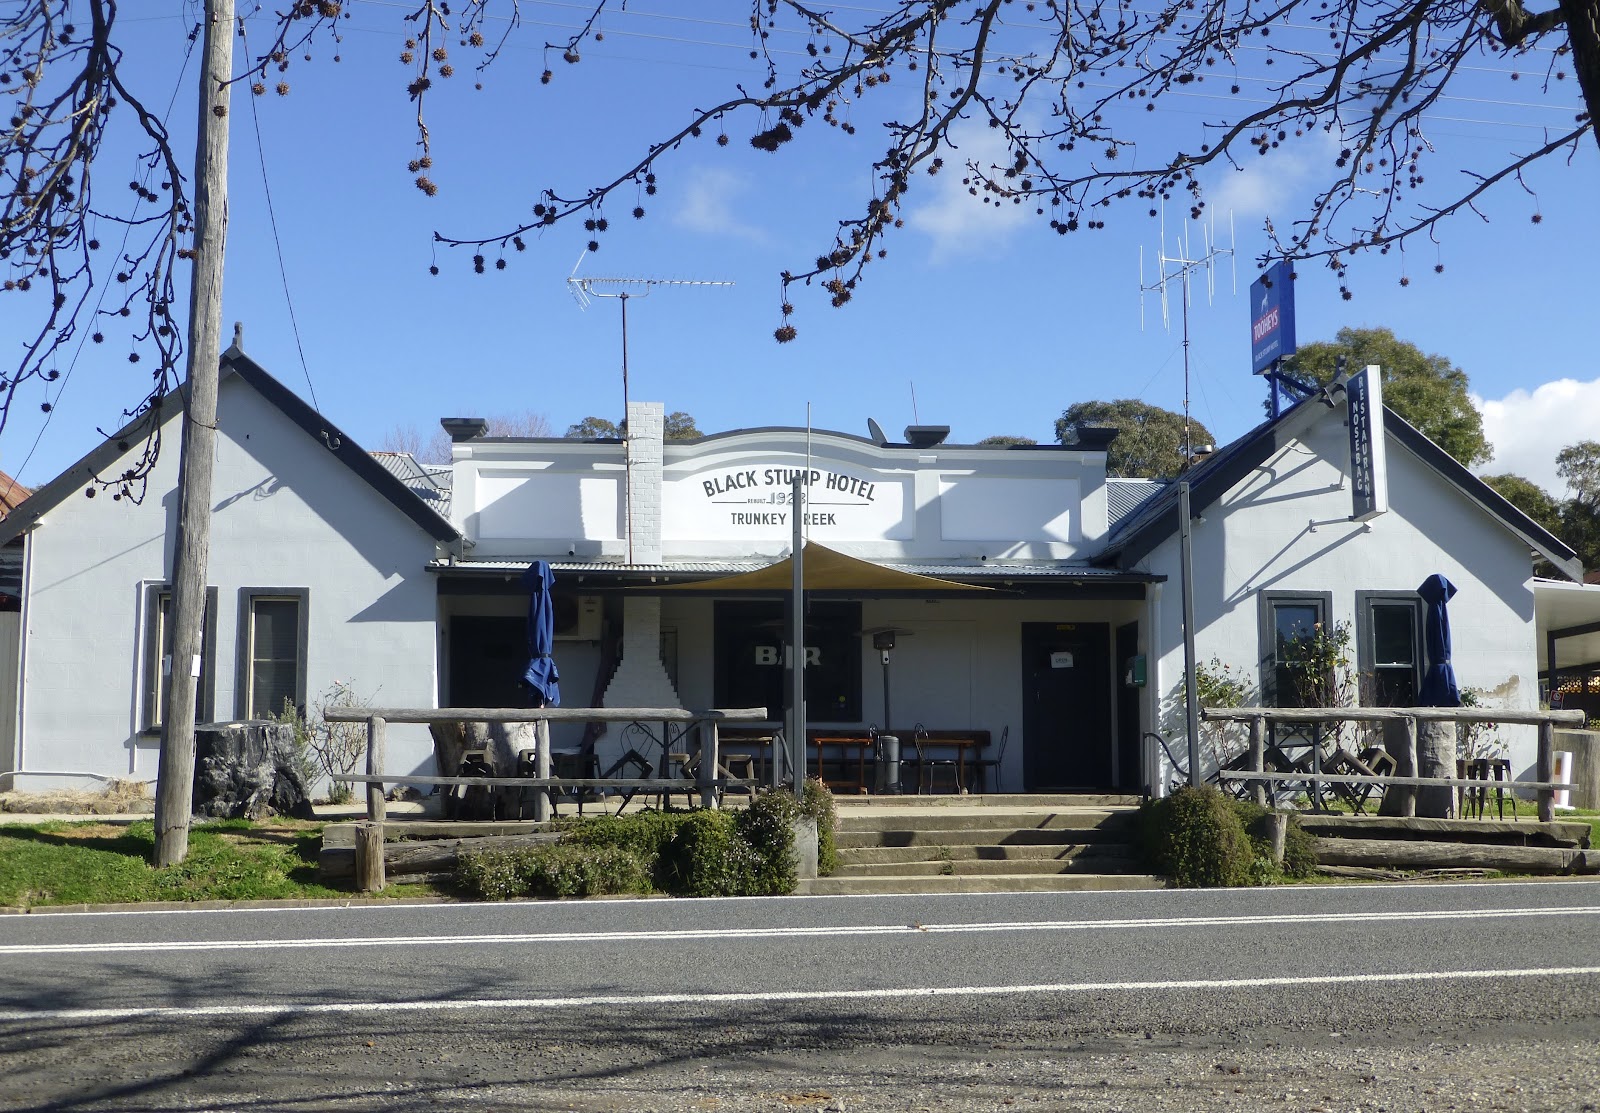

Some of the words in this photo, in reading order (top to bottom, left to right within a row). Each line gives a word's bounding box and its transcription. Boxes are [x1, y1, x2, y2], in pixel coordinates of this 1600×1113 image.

[1254, 310, 1278, 340] TOOHEYS
[1352, 401, 1363, 490] NOSEBAG
[1358, 376, 1370, 509] RESTAURANT
[702, 470, 758, 498] BLACK
[764, 469, 821, 487] STUMP
[826, 472, 876, 502] HOTEL
[731, 512, 787, 525] TRUNKEY
[801, 513, 837, 526] REEK
[755, 645, 822, 666] BR
